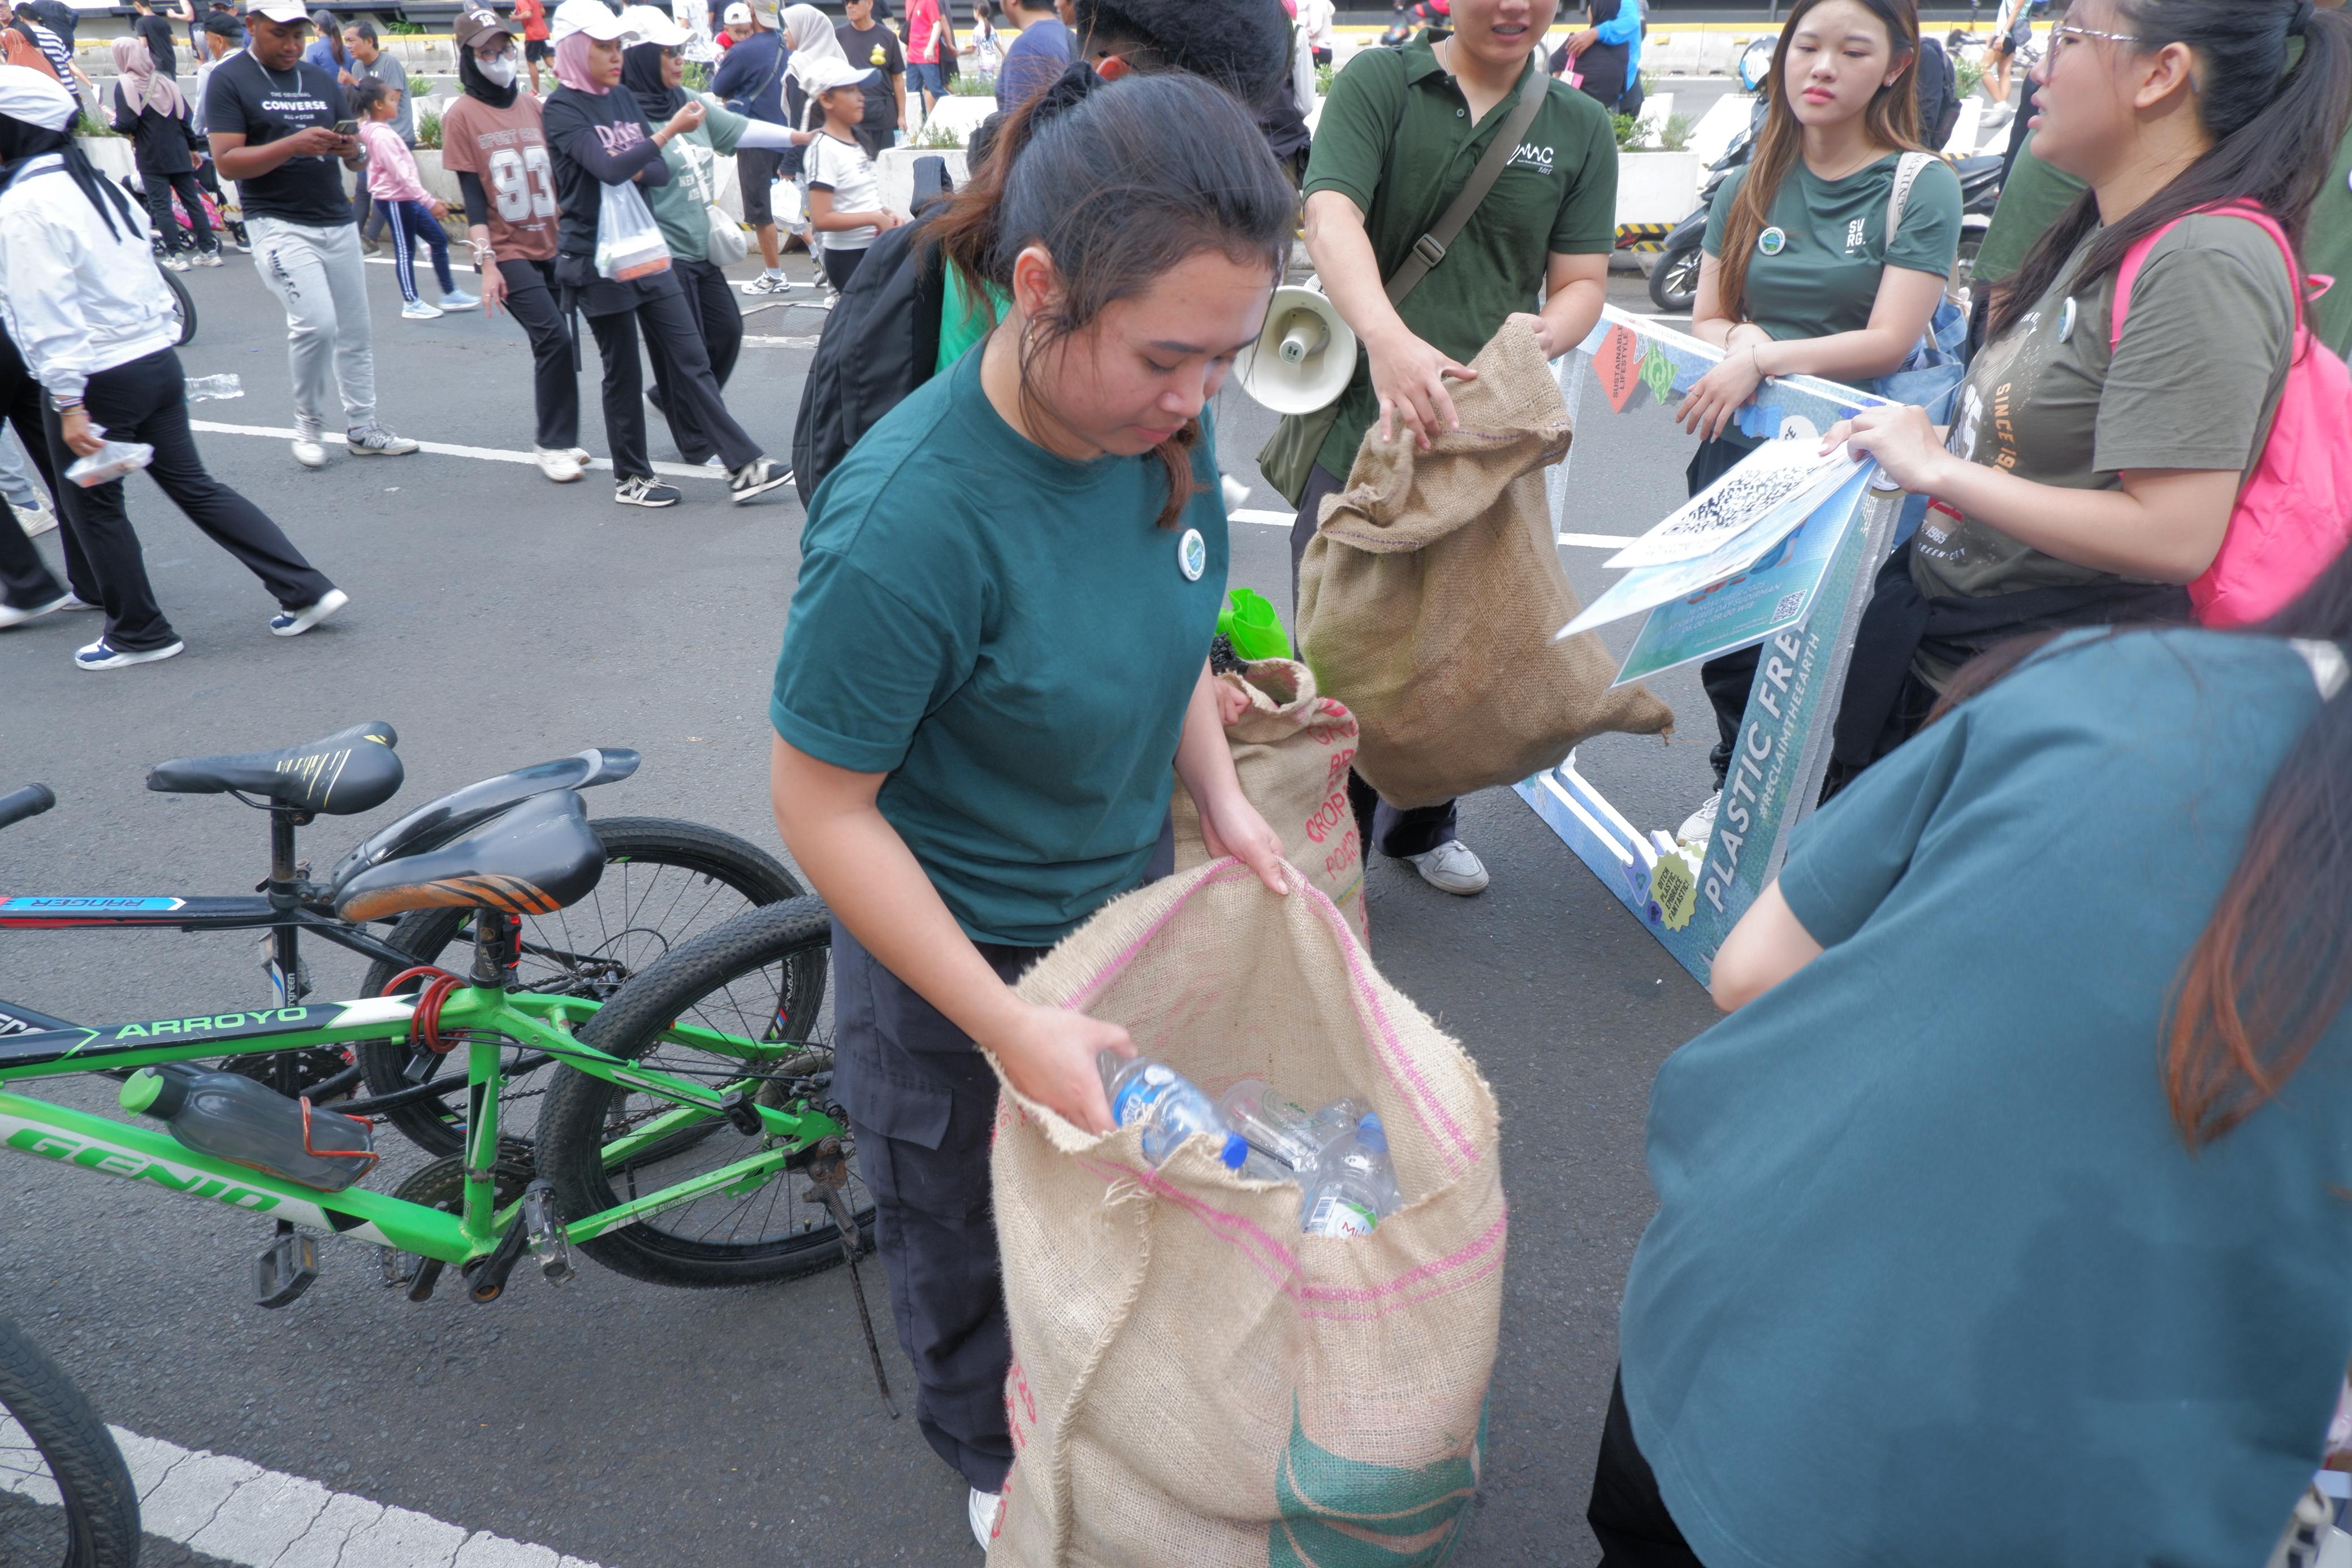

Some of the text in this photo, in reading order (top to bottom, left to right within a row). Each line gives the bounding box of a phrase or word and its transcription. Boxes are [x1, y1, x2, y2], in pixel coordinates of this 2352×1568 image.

[262, 101, 328, 111] CONVERSE
[477, 129, 518, 149] SPORT
[489, 145, 557, 222] 93
[1849, 218, 1865, 233] SV
[1613, 325, 1623, 398] SUSTAINABLE
[1619, 332, 1629, 389] LIFESTYLE
[1994, 382, 2015, 444] SINCE
[1925, 525, 1949, 544] 1965
[1694, 608, 1717, 621] FREE
[1733, 583, 1782, 605] SUDIRMAN
[1745, 580, 1767, 592] 2025
[1710, 608, 1737, 622] 09.00
[1736, 601, 1756, 613] WIB
[1759, 633, 1820, 819] #RECLAIMTHEEARTH
[1705, 624, 1807, 913] PLASTIC FRE
[1657, 867, 1670, 890] DITCH
[1660, 872, 1677, 903] PLASTIC,
[1665, 876, 1683, 909] EMBRACE
[31, 899, 145, 907] RANGER
[1668, 879, 1690, 922] FANTASTIC!
[115, 1007, 307, 1039] ARROYO
[6, 1128, 281, 1212] GENIO
